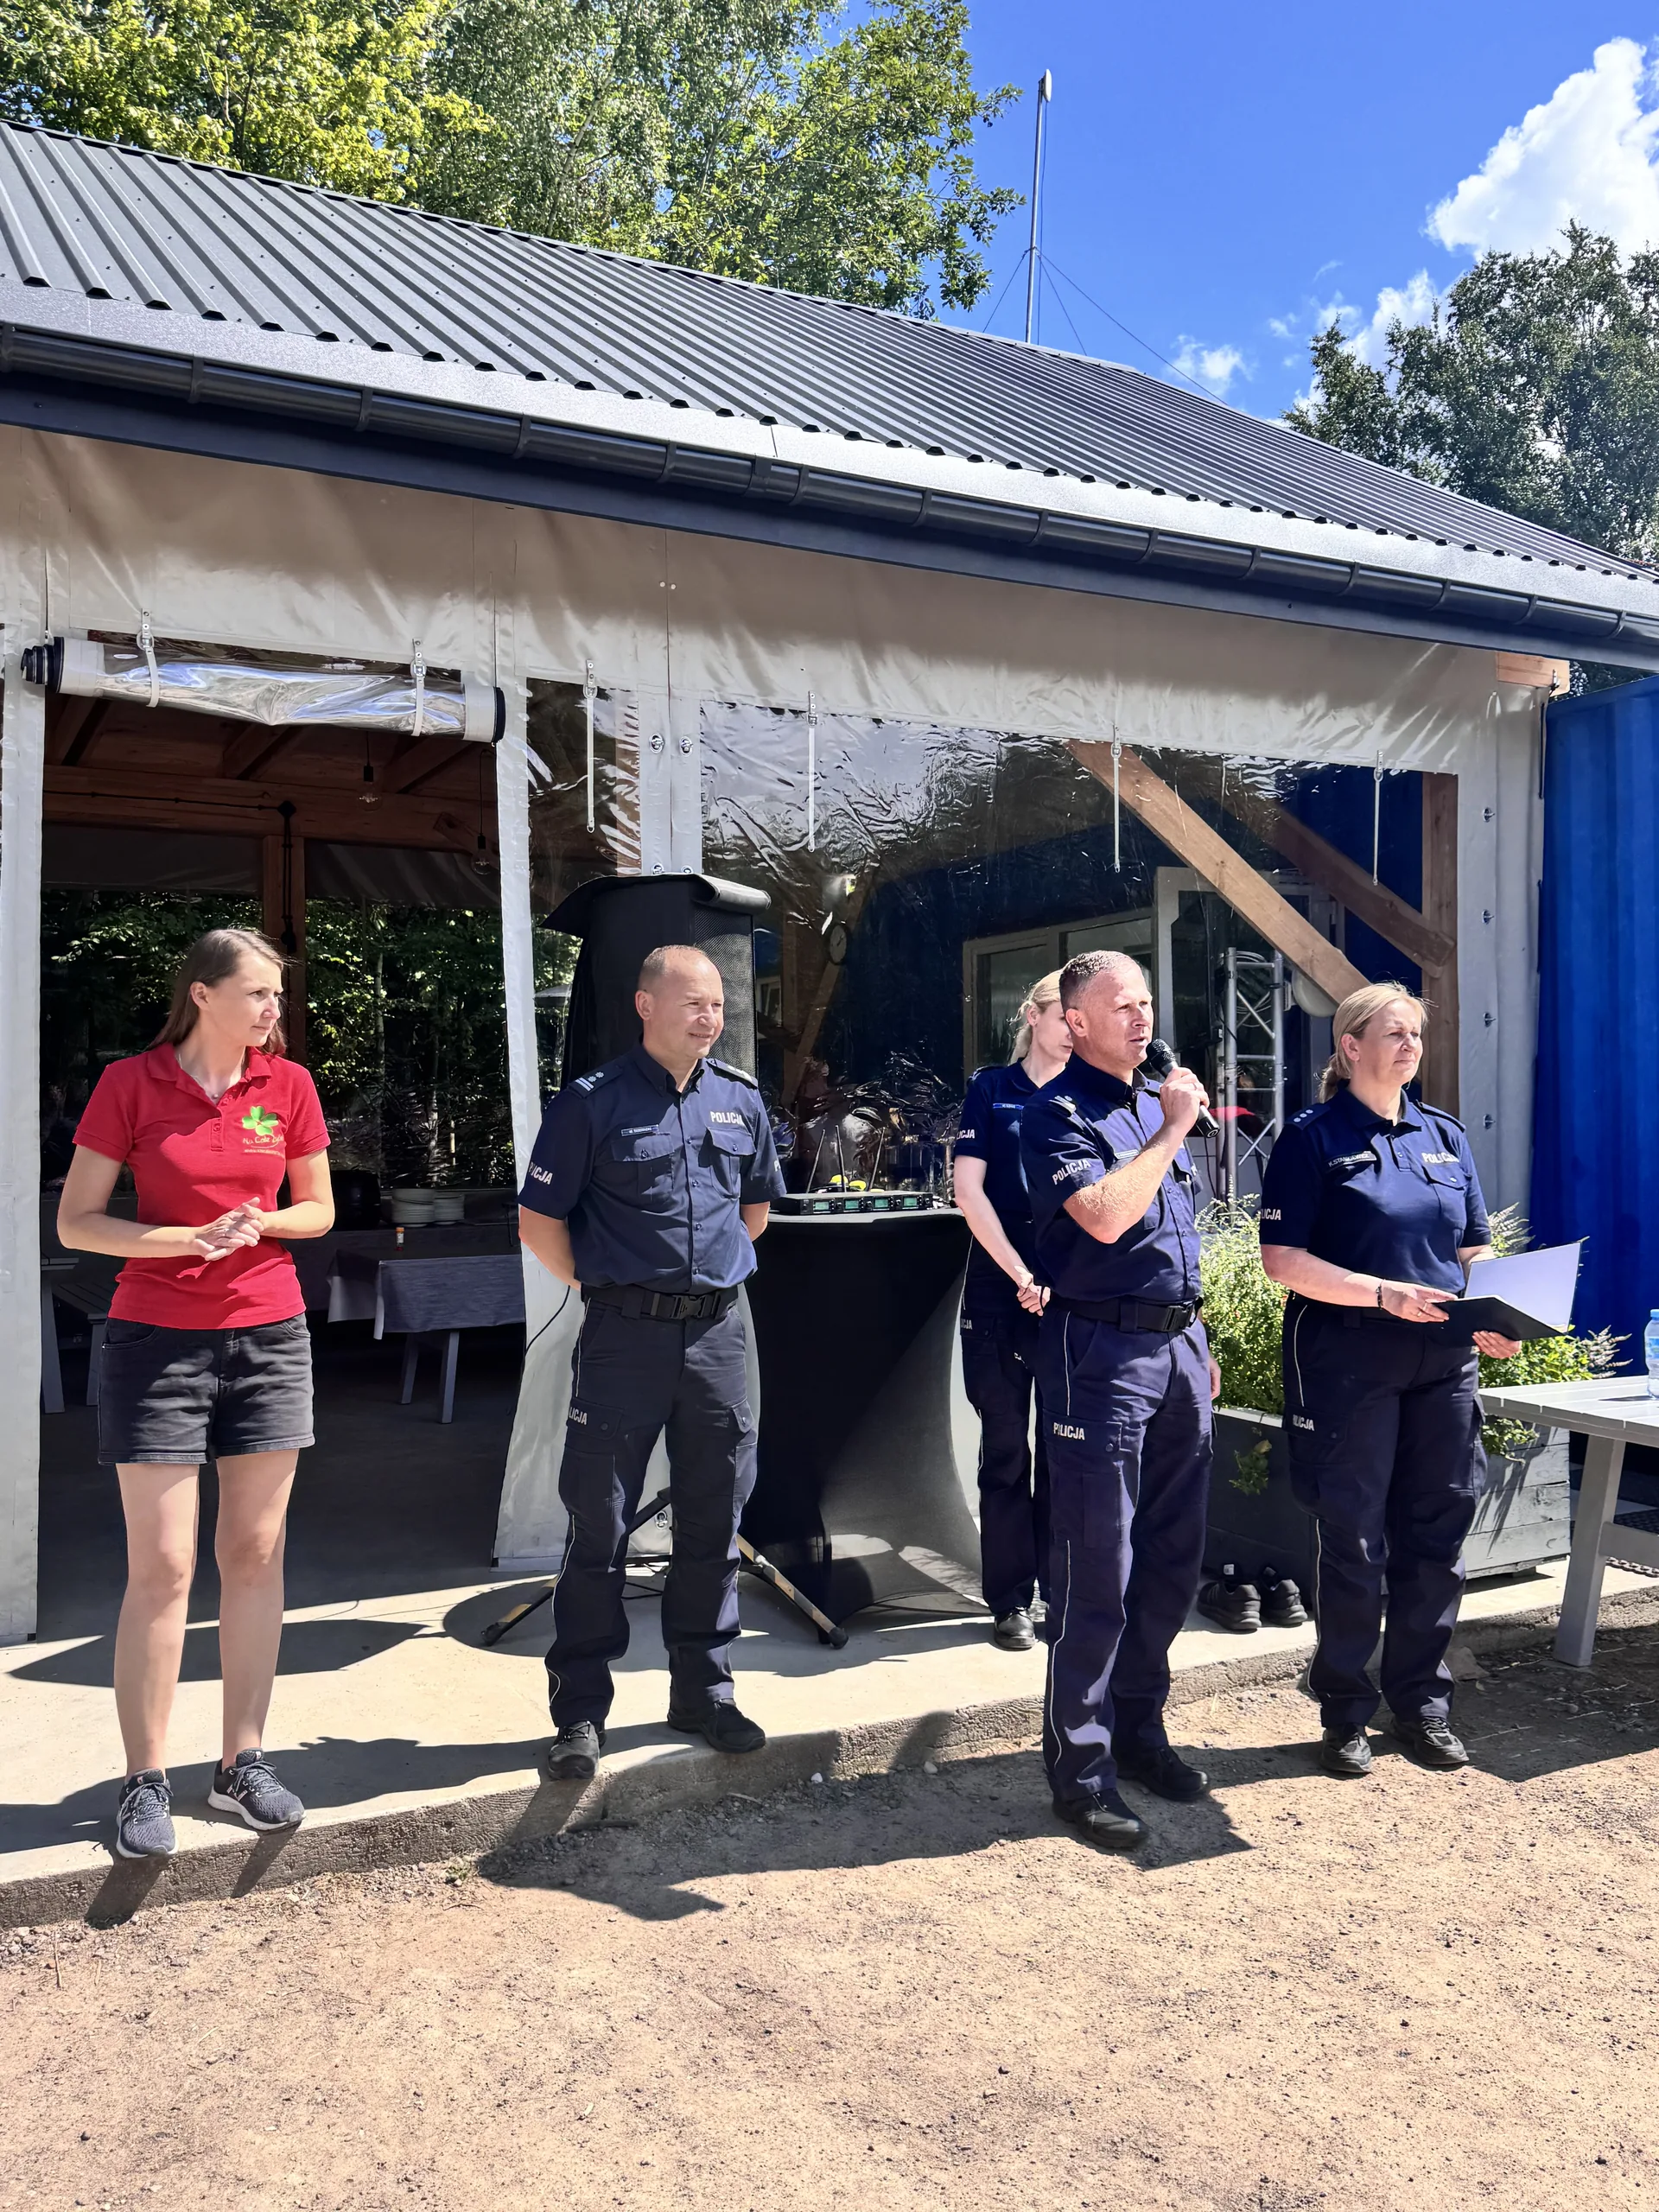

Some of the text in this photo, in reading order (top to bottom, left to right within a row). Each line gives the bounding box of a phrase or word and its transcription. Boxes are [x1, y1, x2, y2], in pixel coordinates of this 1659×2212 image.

[1052, 1159, 1091, 1185] POLICJA
[1261, 1208, 1281, 1220] LICJA
[569, 1407, 588, 1426] LICJA
